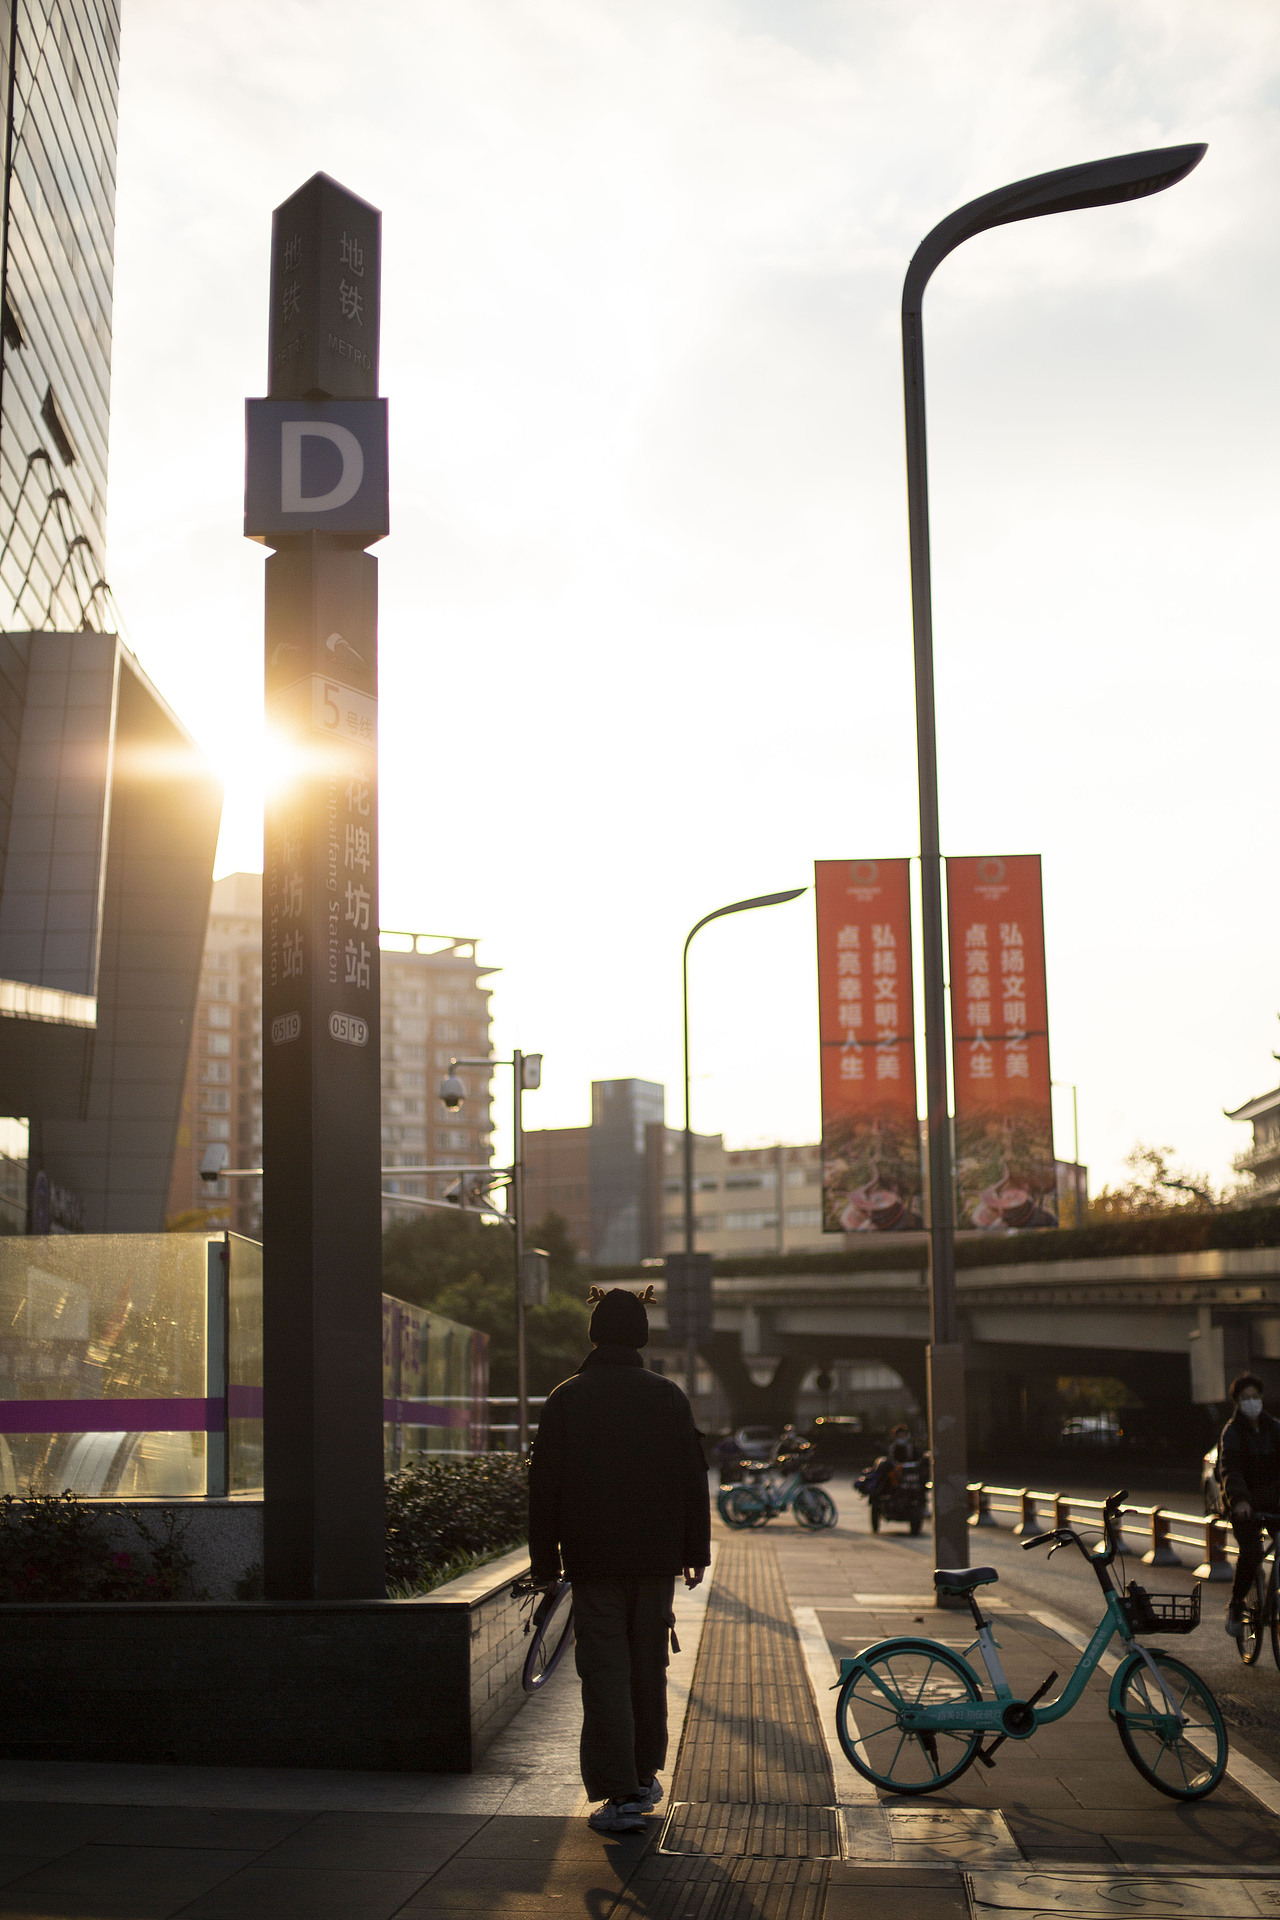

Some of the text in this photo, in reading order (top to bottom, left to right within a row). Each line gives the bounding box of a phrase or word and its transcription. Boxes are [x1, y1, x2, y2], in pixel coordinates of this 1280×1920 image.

[327, 333, 372, 371] METRO
[338, 230, 365, 326] 地铁
[281, 420, 364, 514] D
[271, 903, 279, 987] Station
[325, 764, 341, 984] uapaifang Station
[344, 767, 371, 990] 花牌坊站
[837, 924, 864, 1081] 点亮幸福人生
[871, 924, 900, 1081] 弘扬文明之美
[965, 923, 994, 1080] 点亮幸福人生
[999, 921, 1029, 1079] 弘扬文明之美
